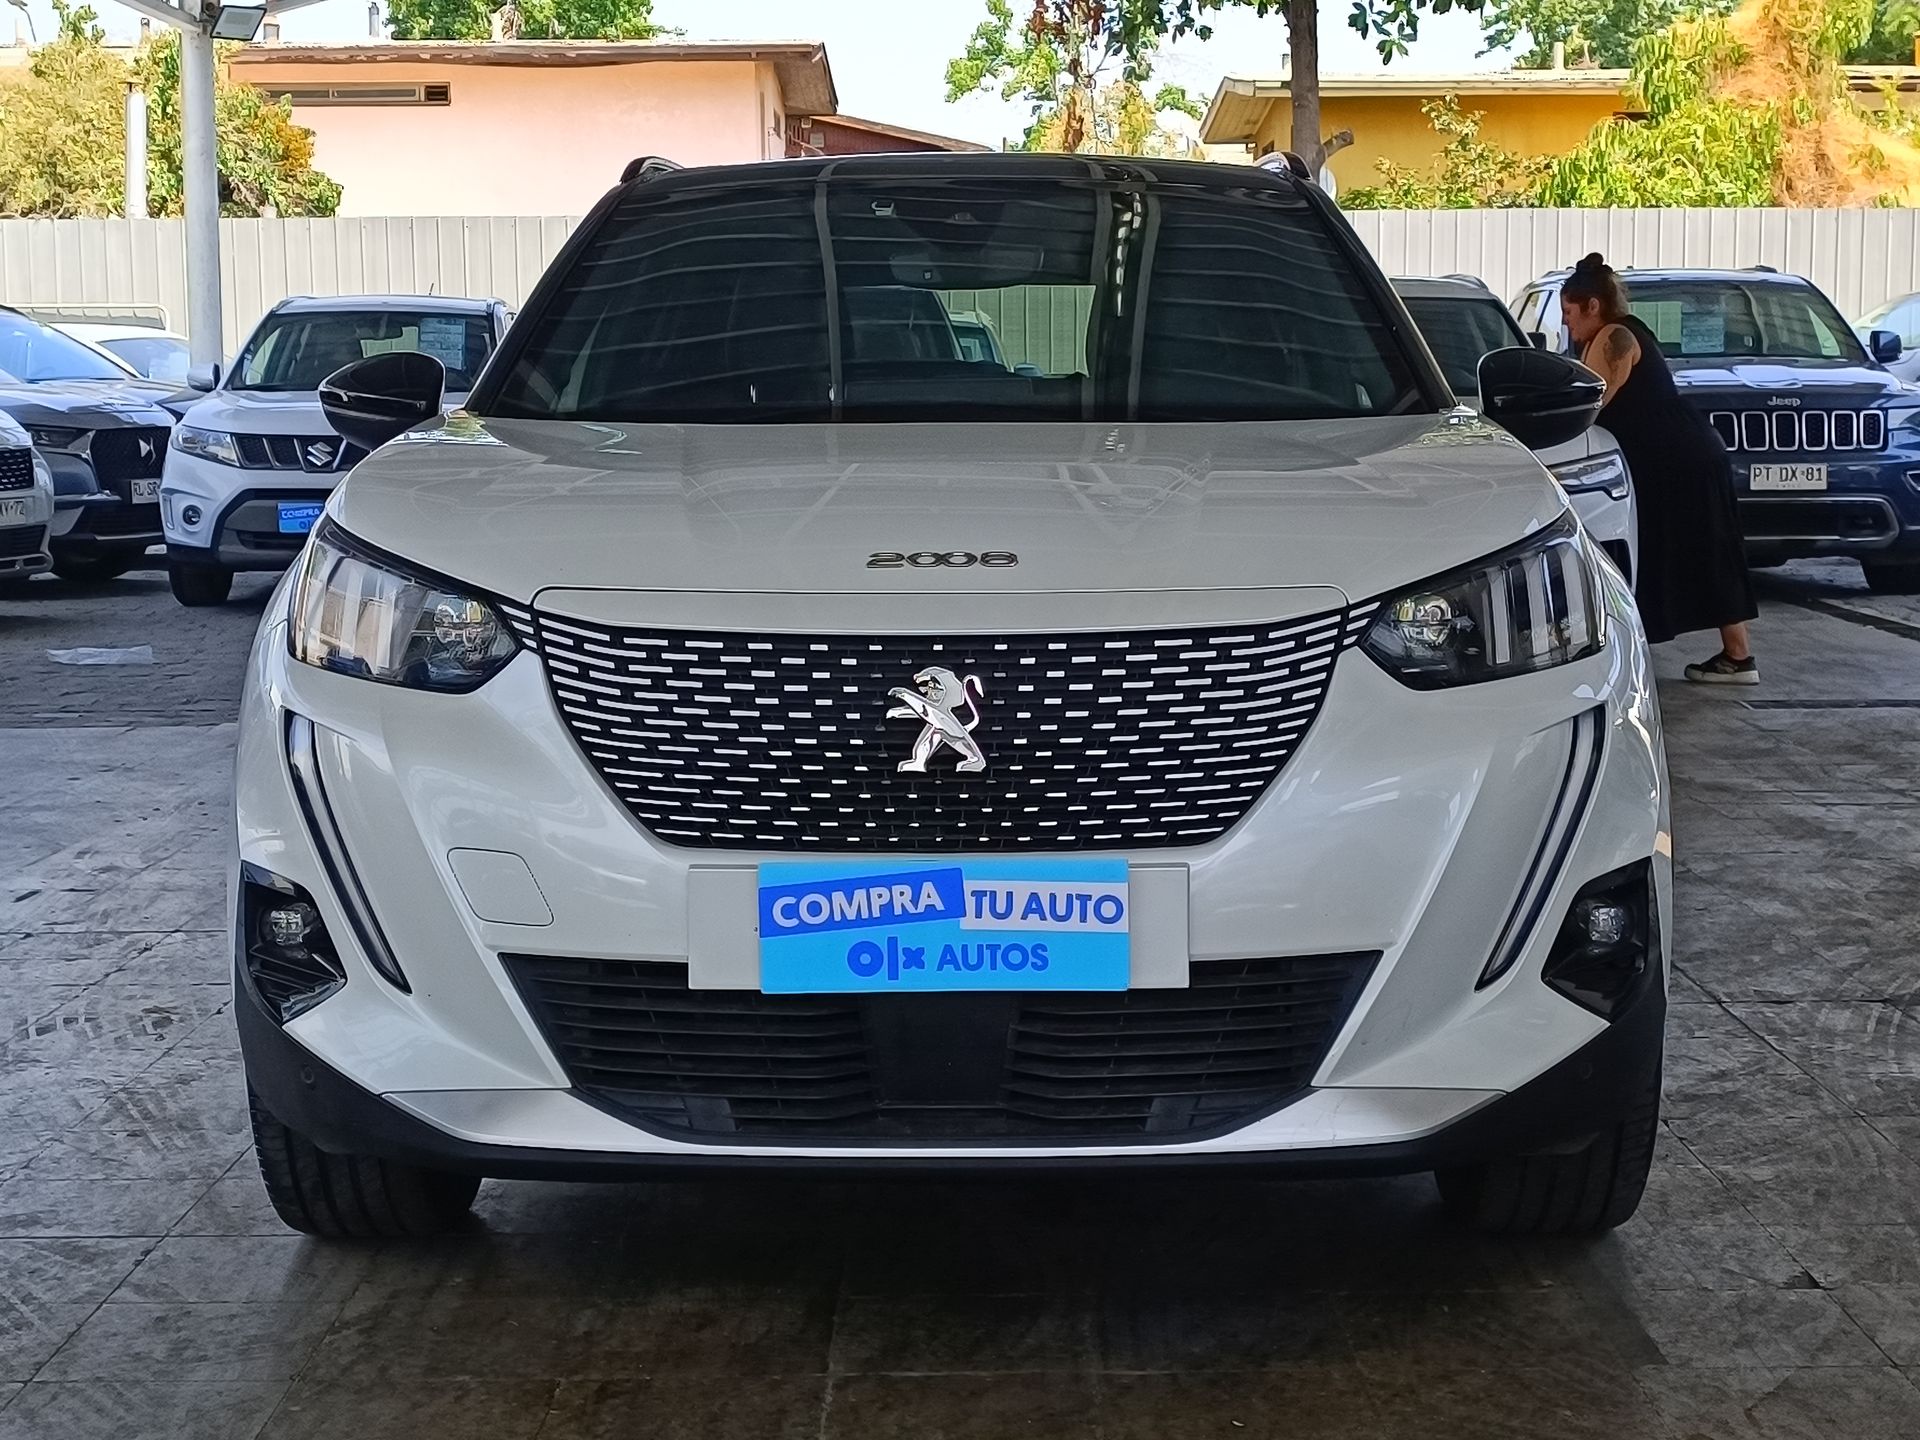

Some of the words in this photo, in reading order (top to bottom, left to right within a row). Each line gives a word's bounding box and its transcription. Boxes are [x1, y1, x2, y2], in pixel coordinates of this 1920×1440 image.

[1766, 396, 1801, 407] Jeep
[1753, 466, 1772, 481] PT
[1779, 465, 1799, 482] DX
[1805, 466, 1823, 481] 81
[866, 551, 1019, 569] 2008
[772, 881, 946, 928] COMPRA
[970, 889, 1014, 920] TU
[1020, 892, 1124, 925] AUTO
[936, 943, 1050, 972] AUTOS
